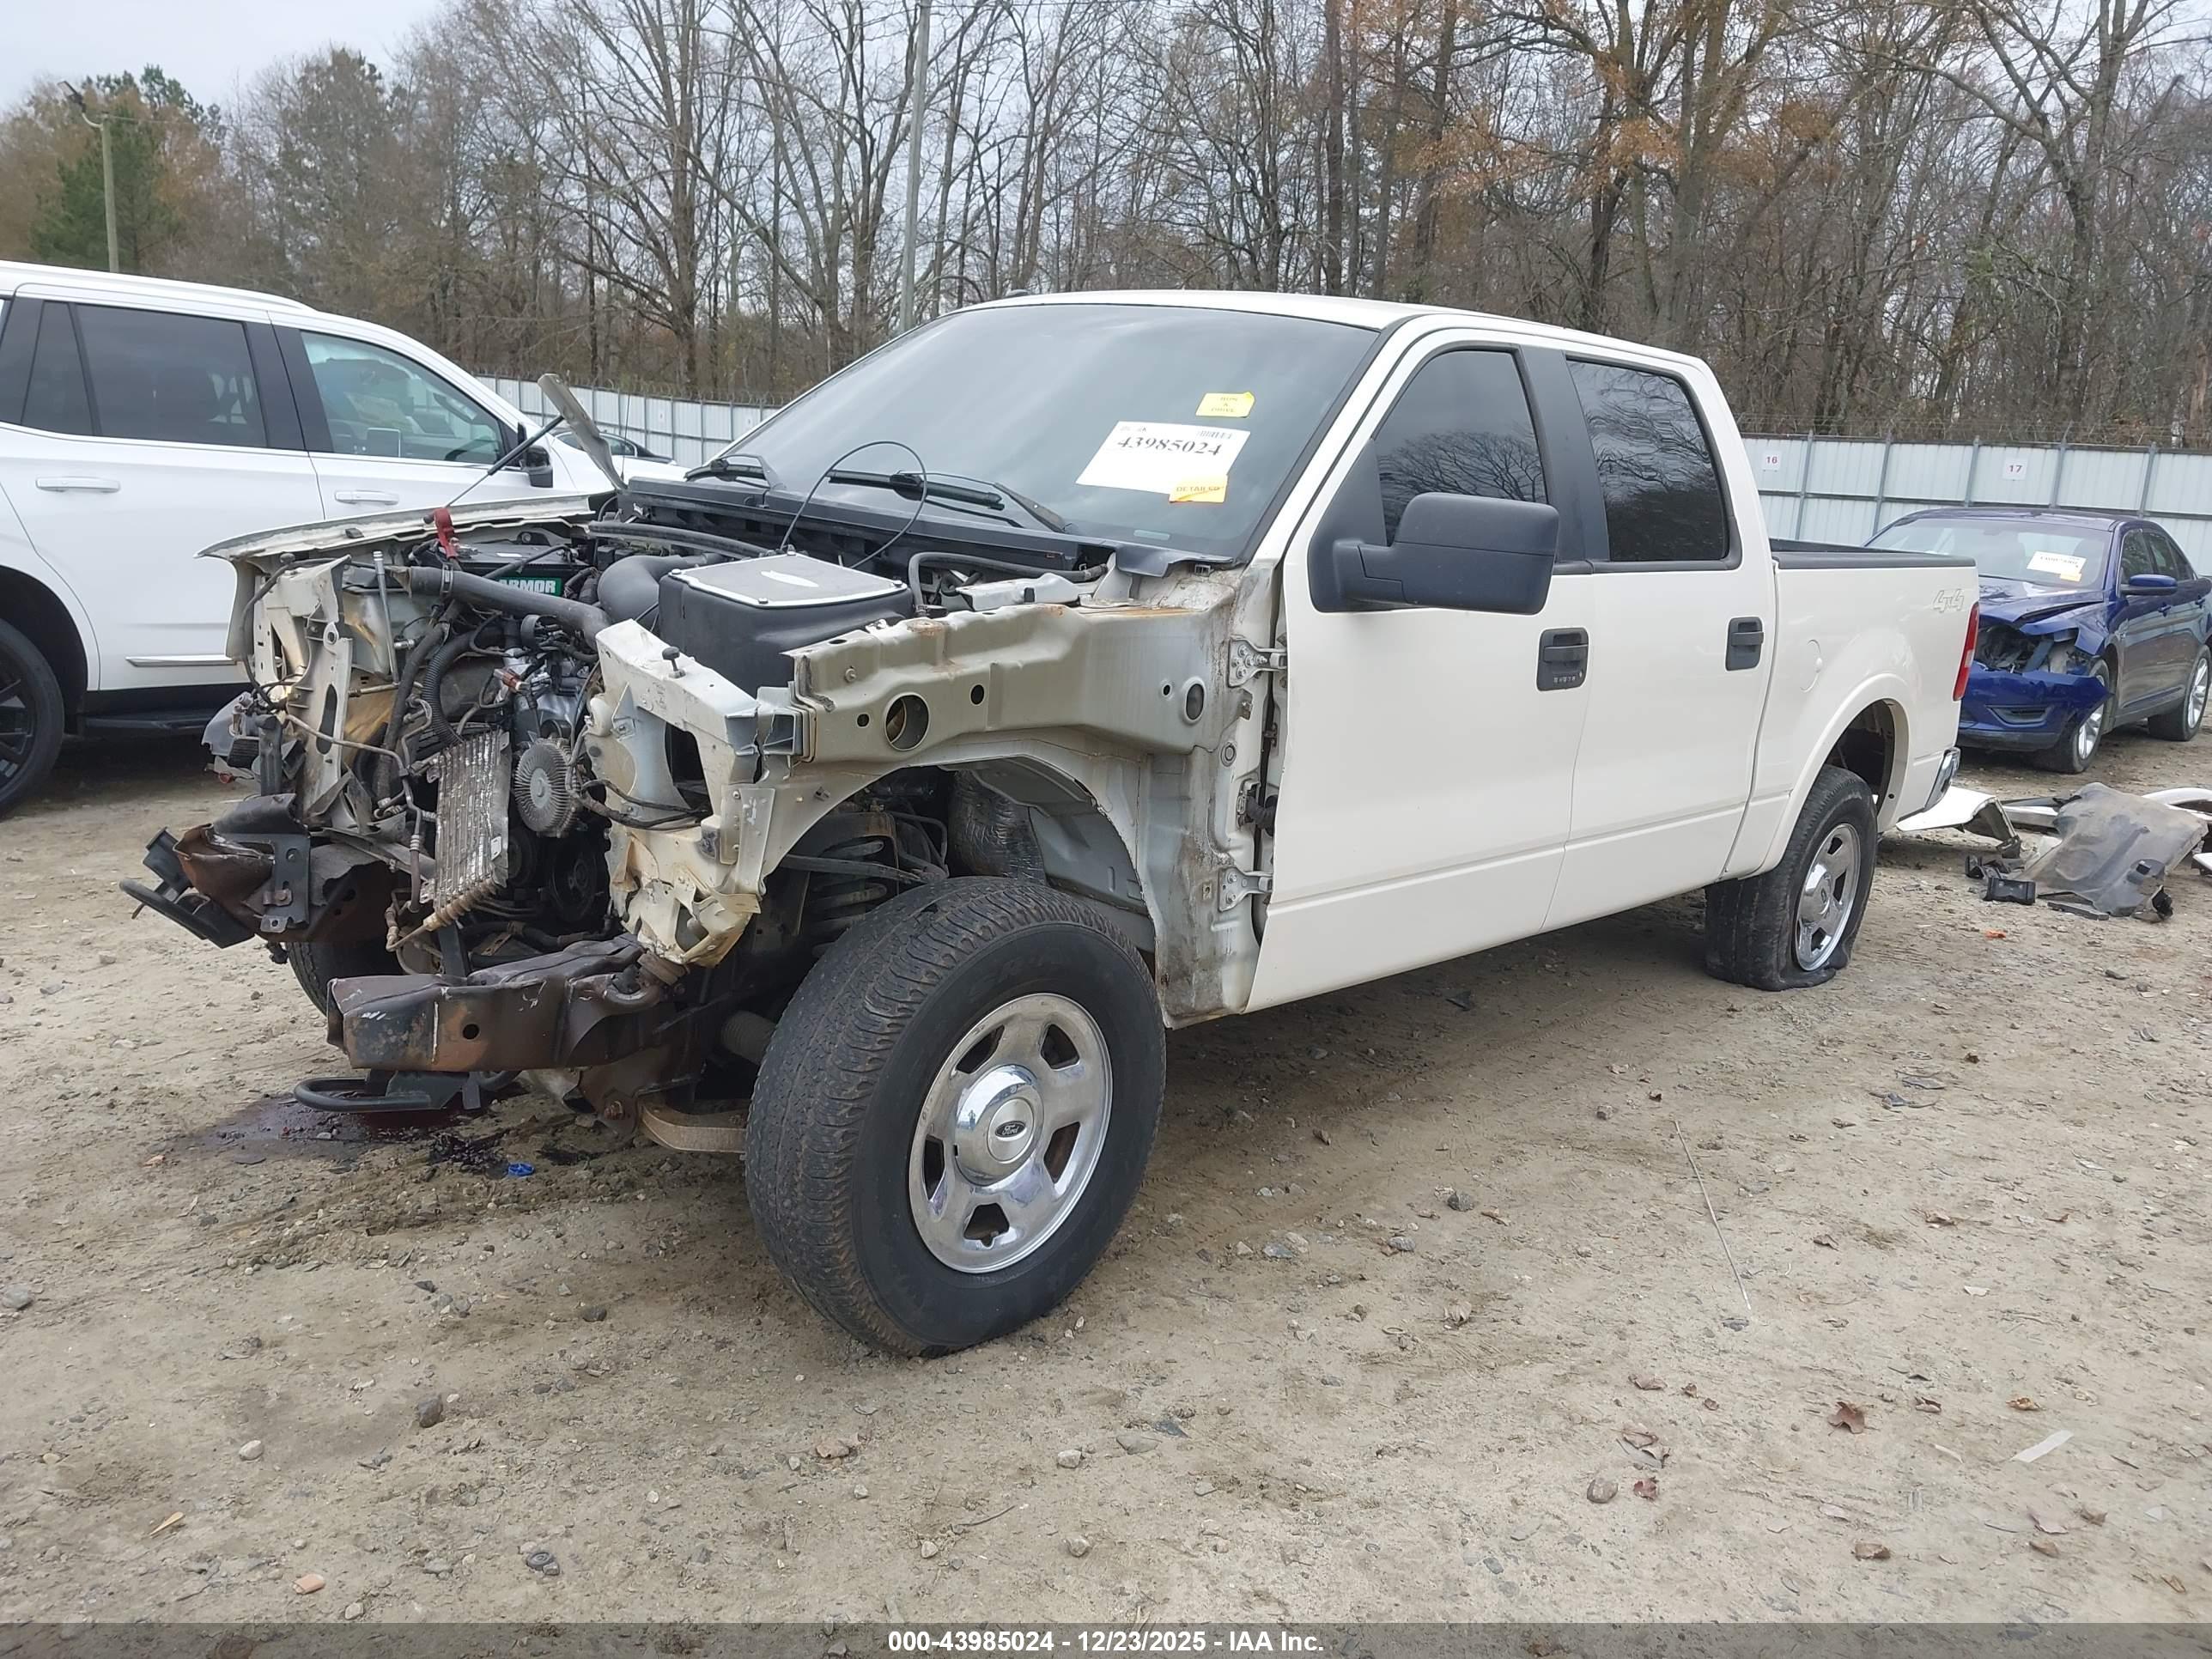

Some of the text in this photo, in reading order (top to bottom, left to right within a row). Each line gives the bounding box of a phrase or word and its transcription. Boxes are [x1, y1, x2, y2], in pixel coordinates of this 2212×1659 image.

[1117, 436, 1222, 456] 43985024
[2009, 465, 2022, 473] 17
[1001, 1124, 1020, 1135] Ford
